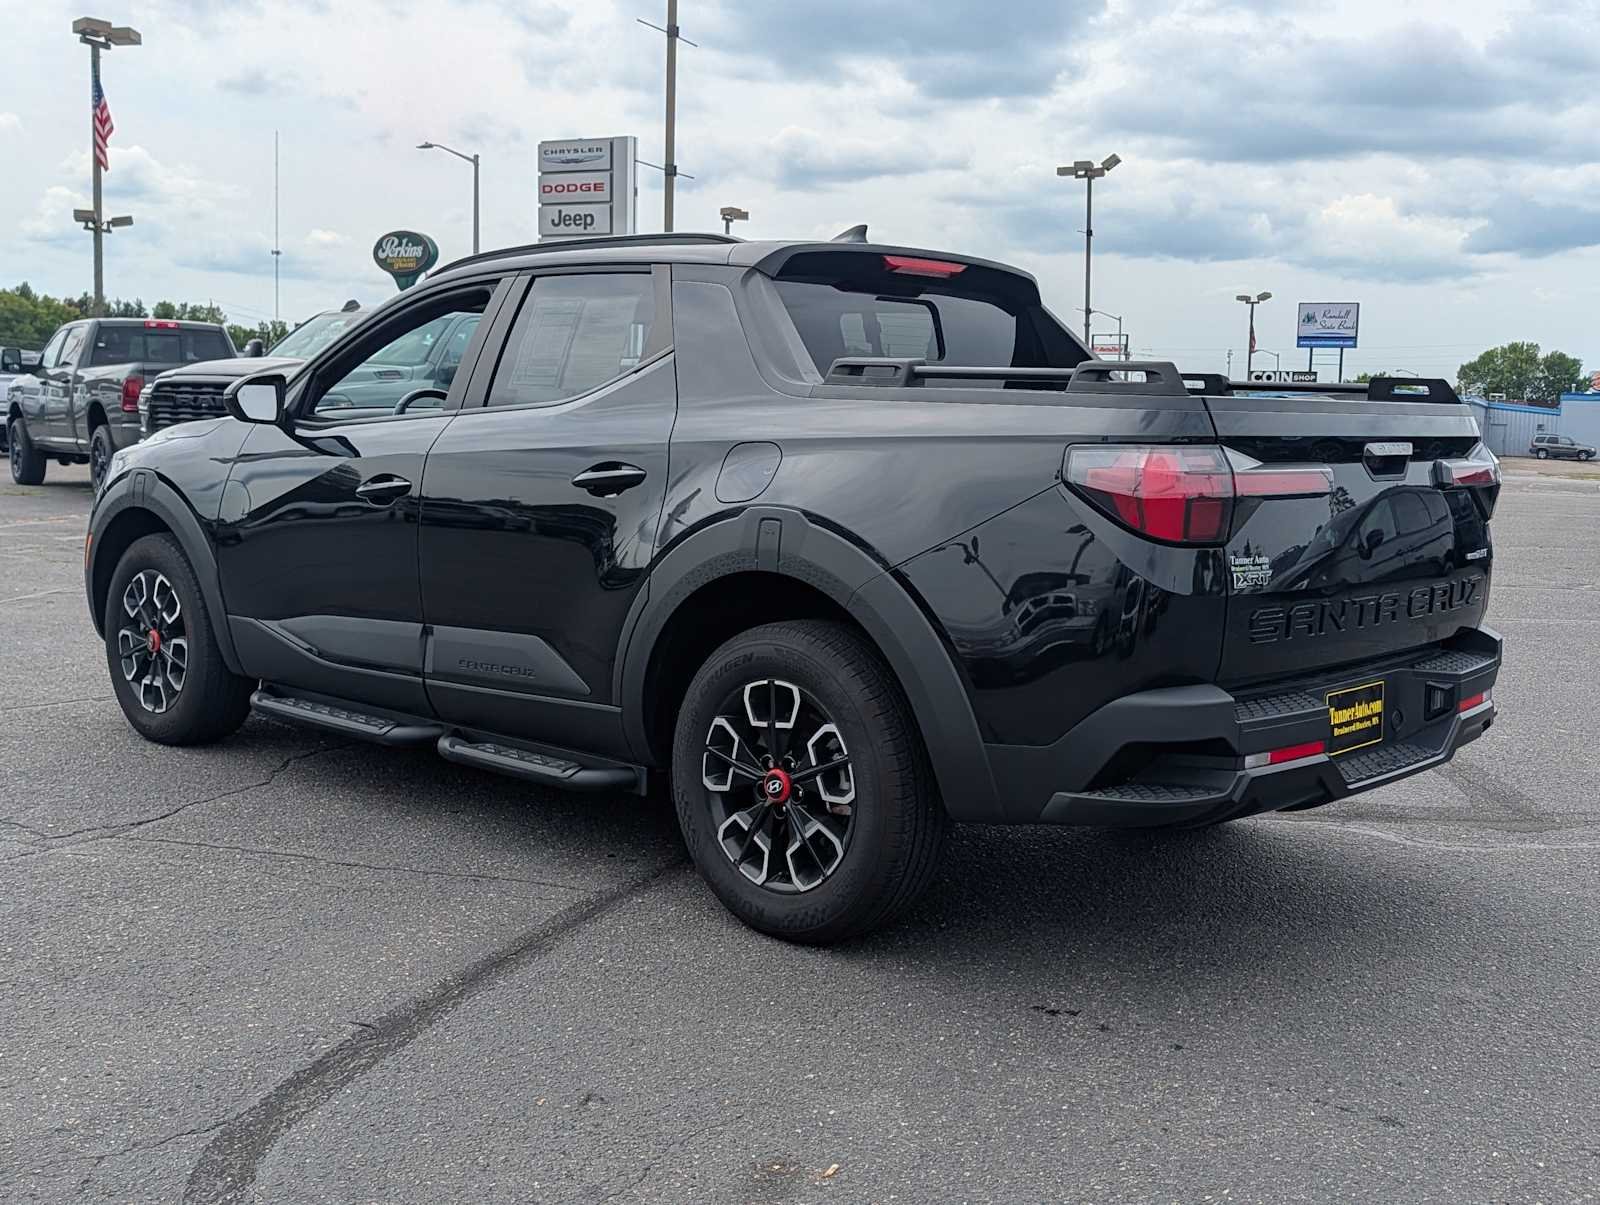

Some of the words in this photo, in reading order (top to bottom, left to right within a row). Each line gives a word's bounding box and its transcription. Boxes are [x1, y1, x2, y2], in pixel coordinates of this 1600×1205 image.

[543, 147, 603, 156] CHRYSLER
[542, 182, 605, 194] DODGE
[551, 209, 595, 230] Jeep
[377, 236, 424, 259] Perkins
[1250, 371, 1293, 383] COIN
[1254, 555, 1270, 565] Auto
[1233, 570, 1273, 589] XRT
[1250, 592, 1401, 645] SANTA
[1406, 575, 1482, 620] CRUZ
